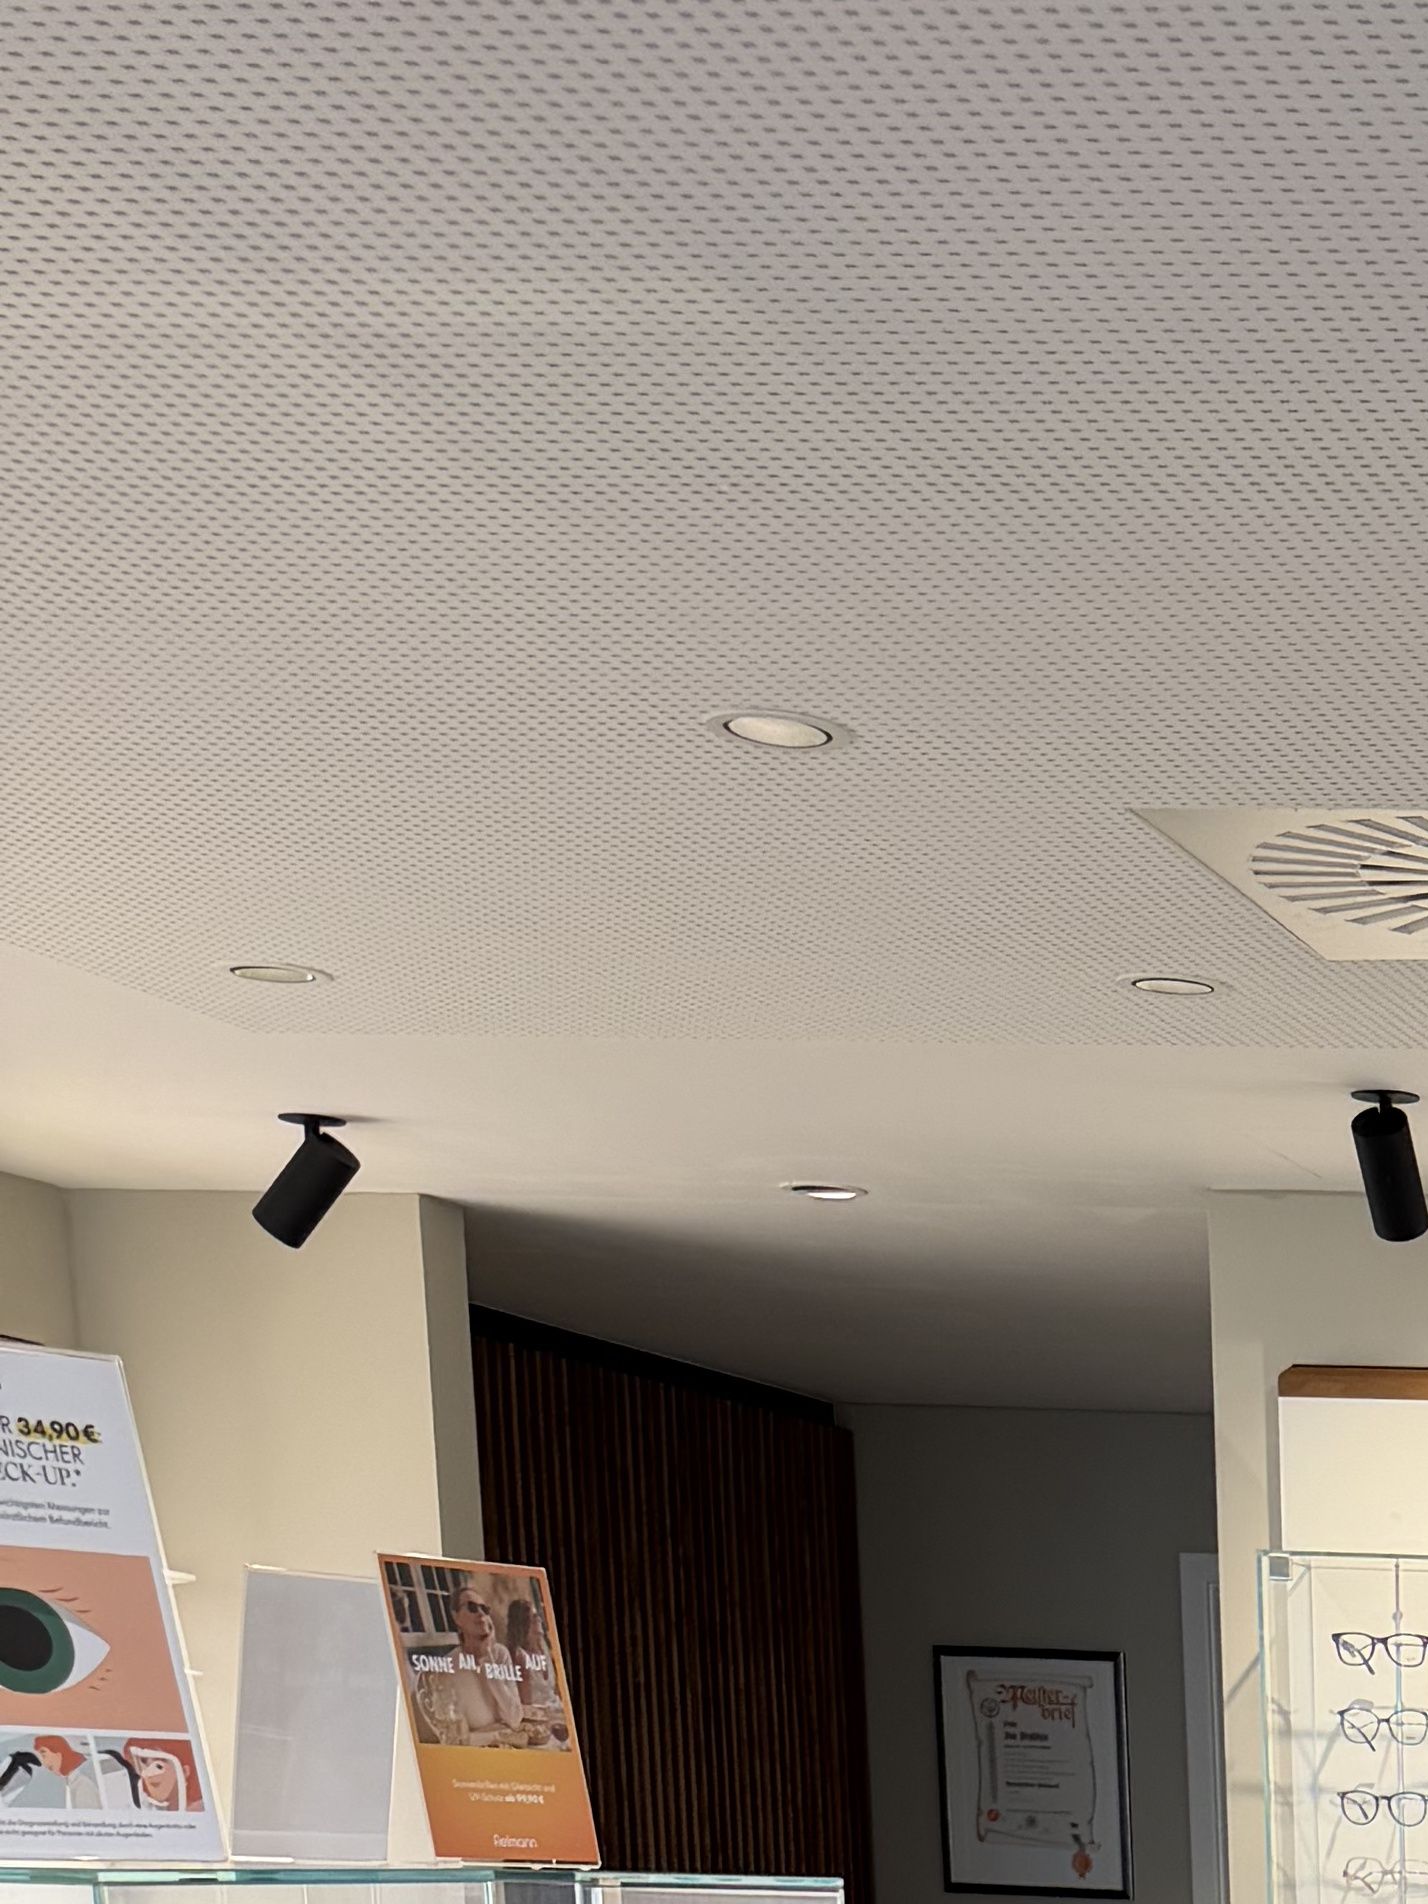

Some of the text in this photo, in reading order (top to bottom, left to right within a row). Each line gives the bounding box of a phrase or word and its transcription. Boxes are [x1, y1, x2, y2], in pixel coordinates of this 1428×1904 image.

[412, 1652, 547, 1682] SONNE AN, BRILLE AUF
